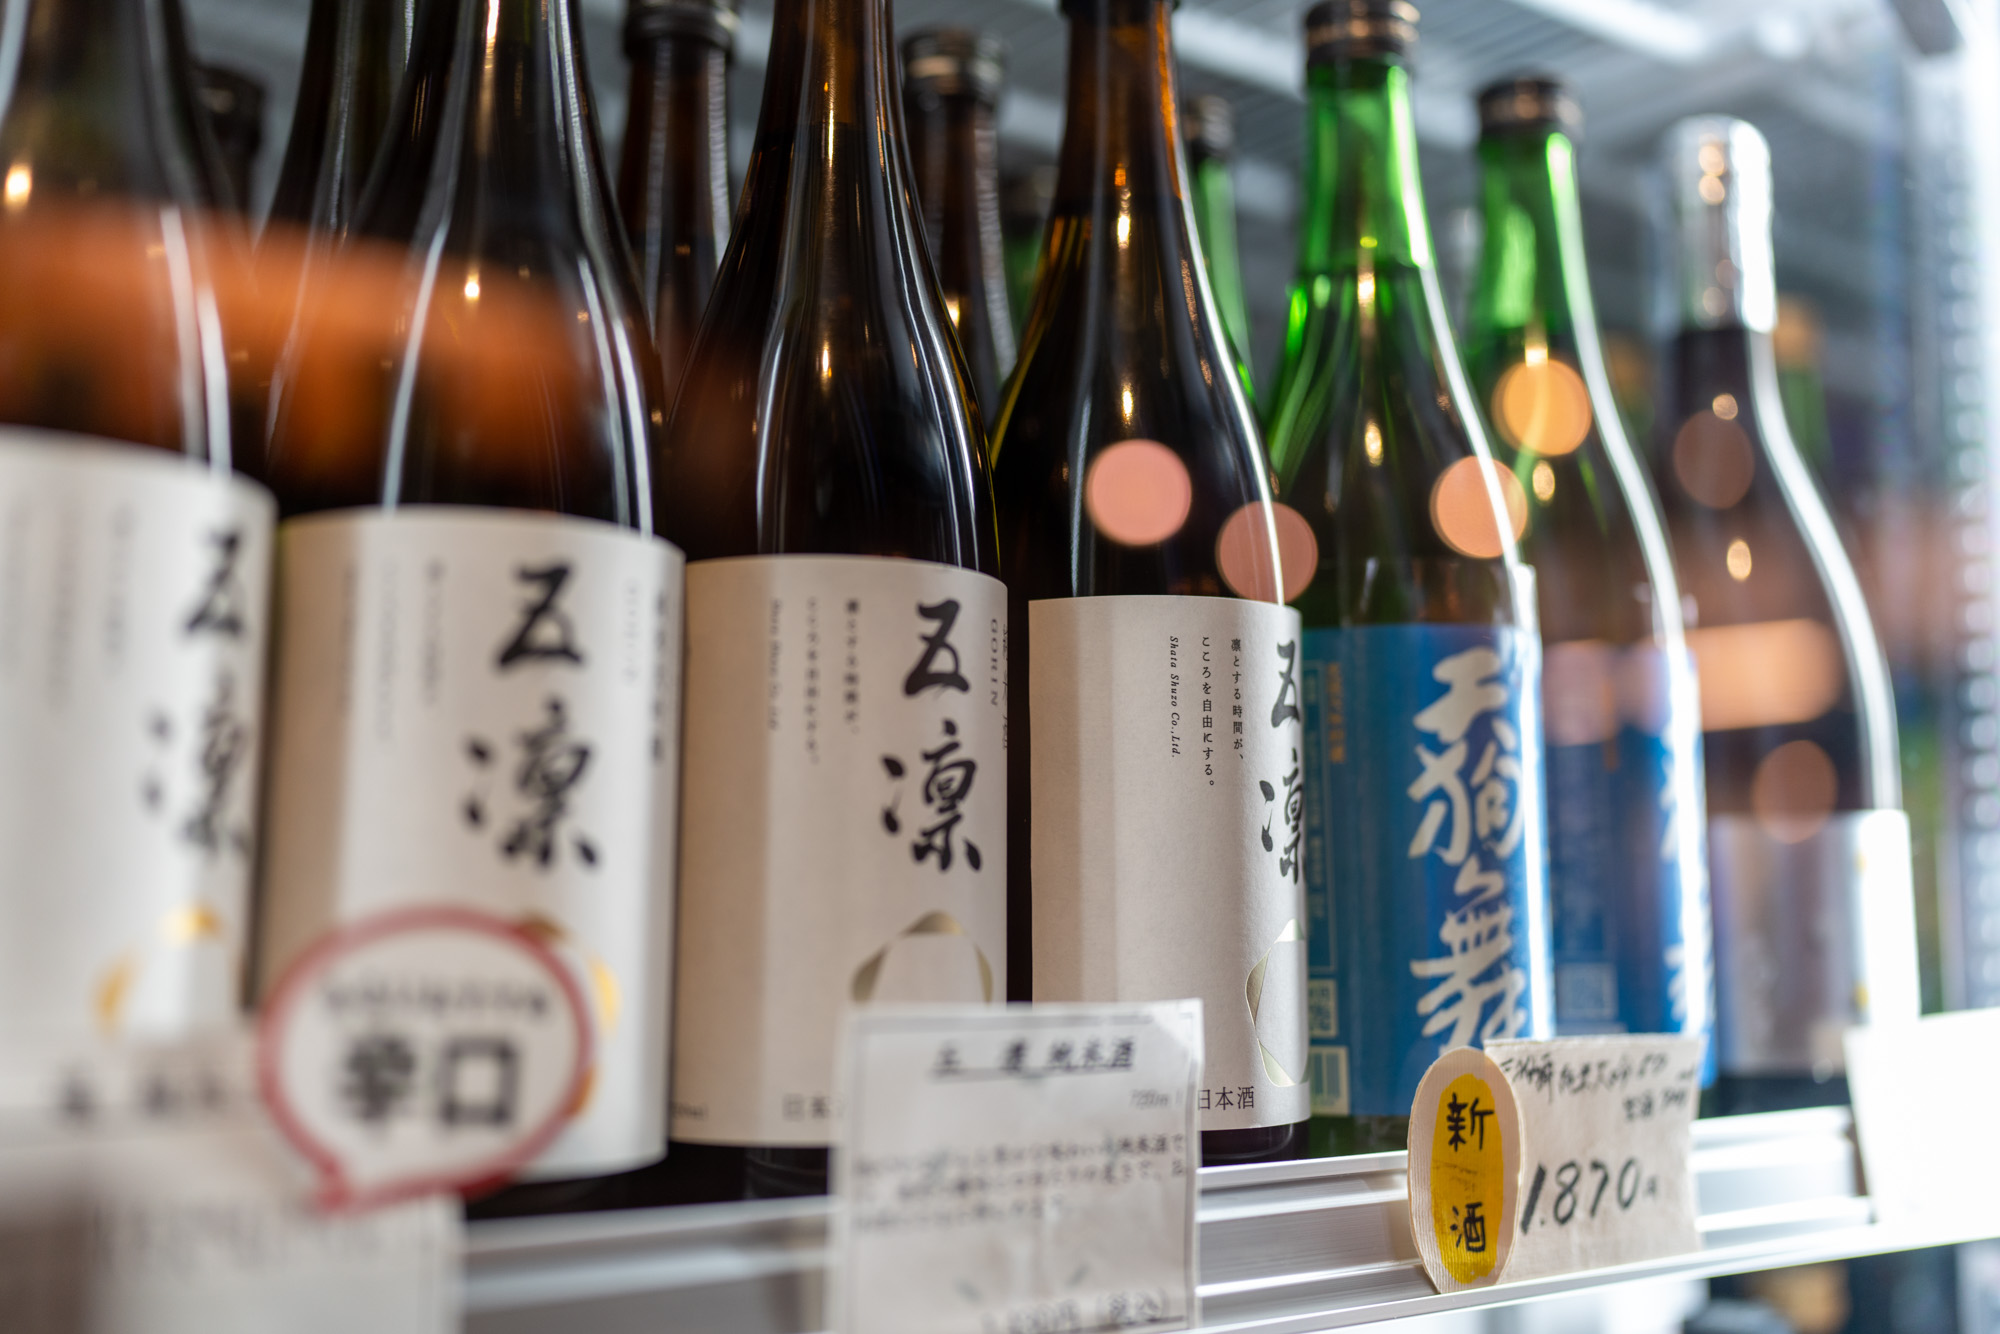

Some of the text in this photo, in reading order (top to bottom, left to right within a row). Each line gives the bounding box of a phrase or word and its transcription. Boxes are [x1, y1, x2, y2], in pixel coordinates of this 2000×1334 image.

[1170, 636, 1179, 668] Shata
[1170, 674, 1179, 707] Shuzo
[1201, 636, 1215, 786] こころを自由にする。
[1406, 645, 1528, 1062] 天狗舞
[1198, 1086, 1255, 1110] 日本酒
[1446, 1092, 1494, 1252] 新酒
